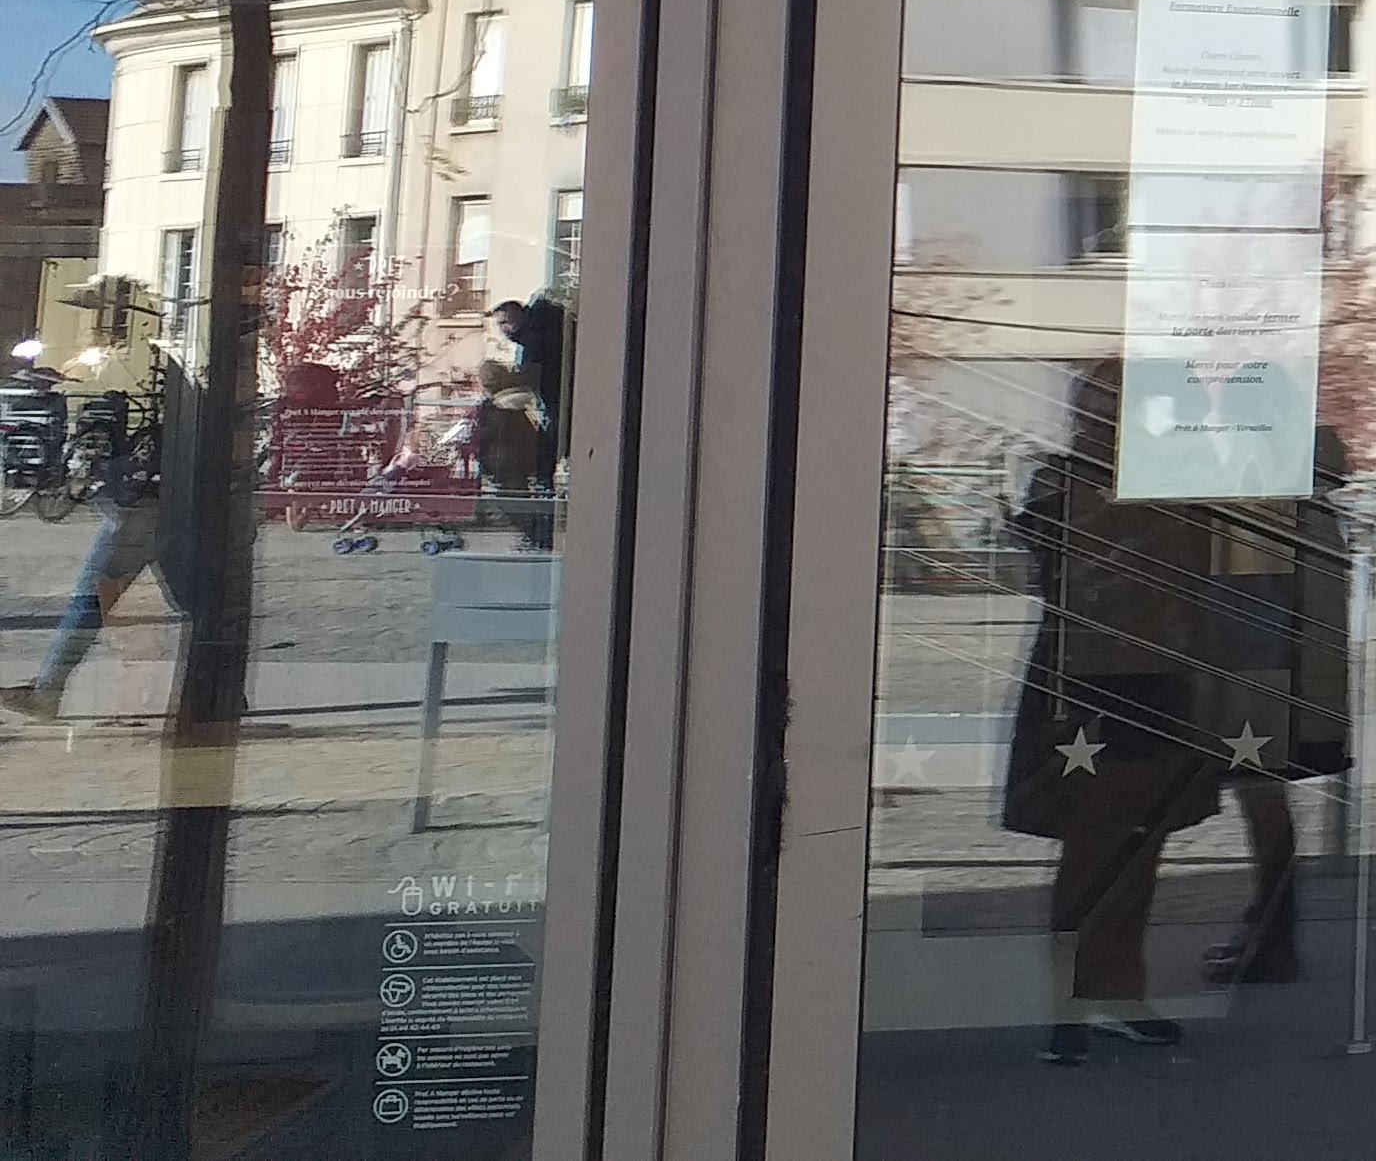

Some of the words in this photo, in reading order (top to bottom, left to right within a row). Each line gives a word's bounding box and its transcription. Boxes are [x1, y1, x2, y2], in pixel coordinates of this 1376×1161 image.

[1215, 361, 1241, 371] pour
[1242, 361, 1269, 369] votre
[329, 498, 356, 515] PRET
[370, 498, 413, 515] MANGER
[429, 899, 540, 915] GRATUIT
